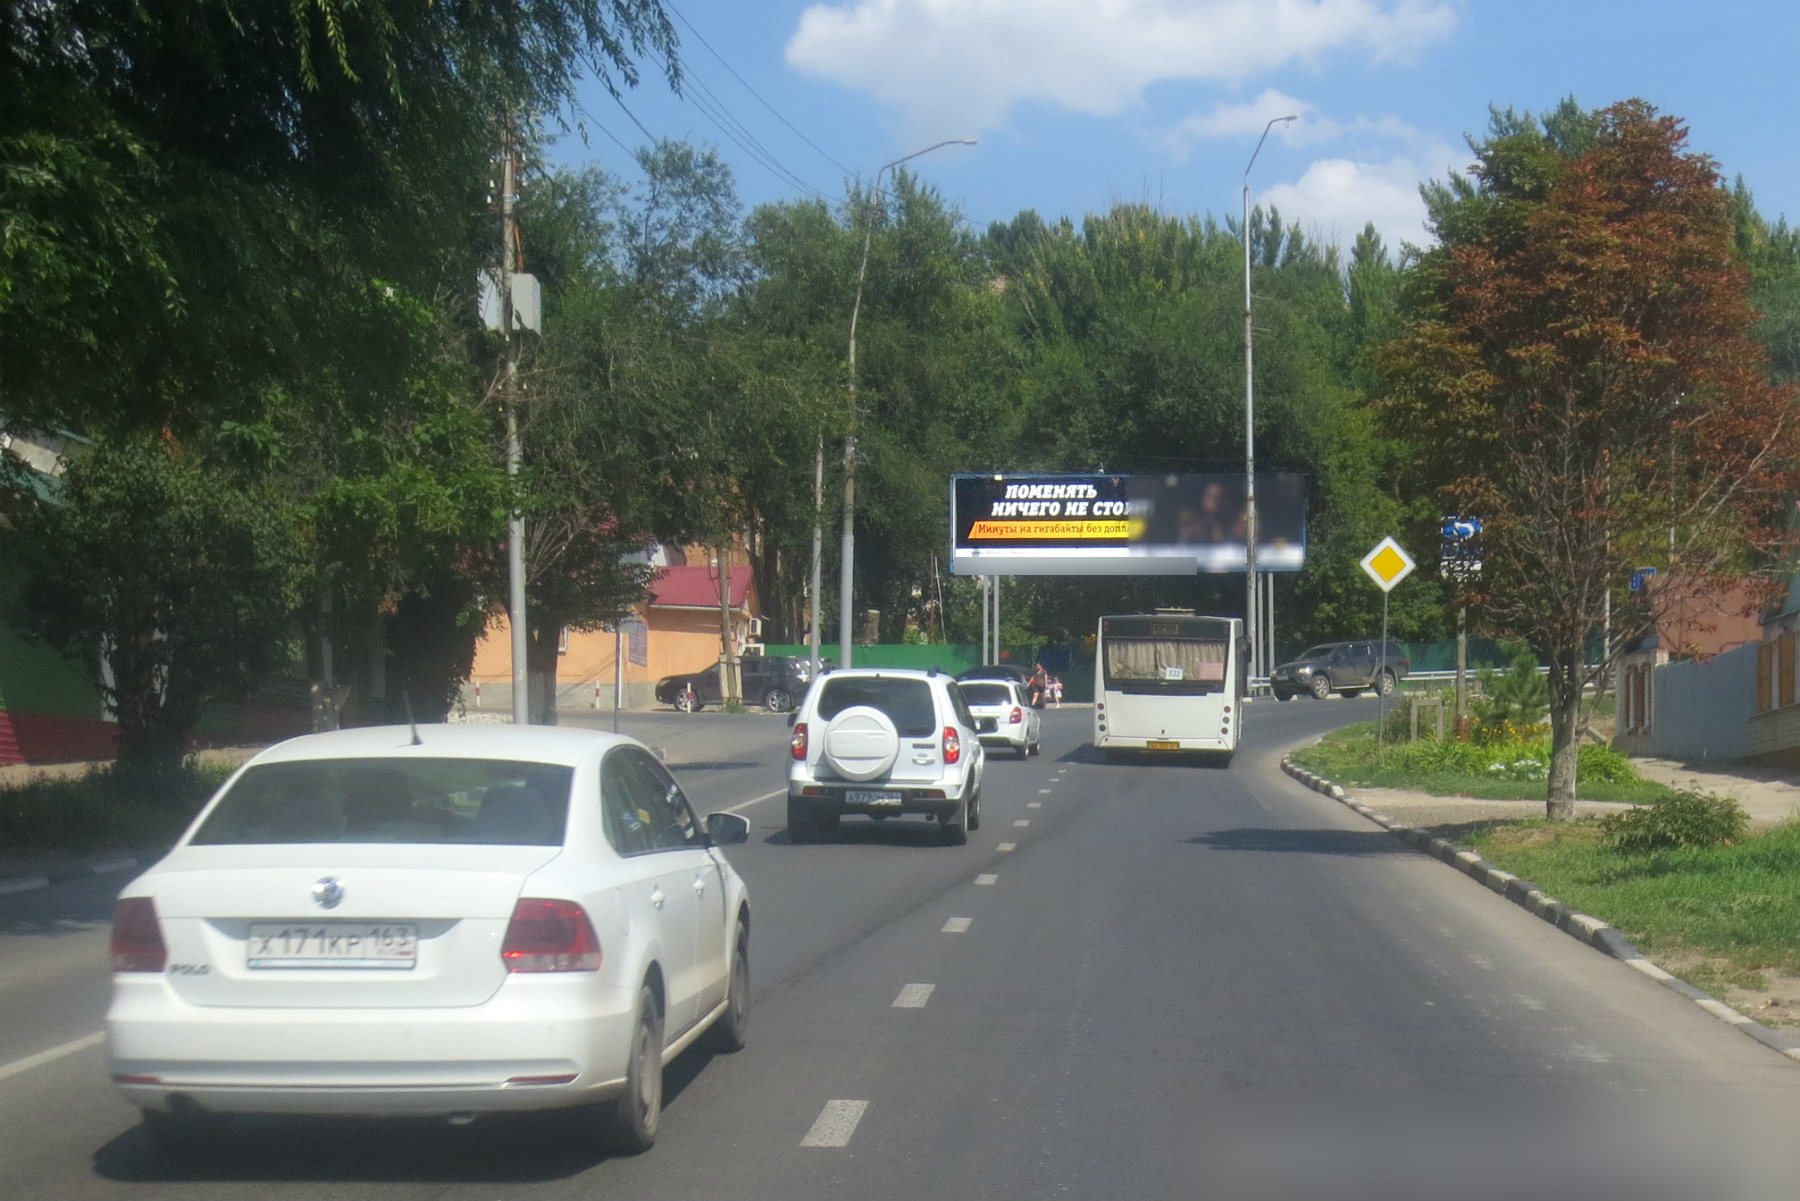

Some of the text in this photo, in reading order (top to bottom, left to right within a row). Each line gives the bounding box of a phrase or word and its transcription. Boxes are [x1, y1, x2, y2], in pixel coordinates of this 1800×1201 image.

[1004, 484, 1098, 499] ПОМЕНЯТЬ
[991, 501, 1061, 516] НИЧЕГО
[1064, 501, 1089, 516] НЕ
[978, 523, 1018, 536] Минуты
[1034, 523, 1084, 533] гигабайты
[1086, 523, 1102, 533] без
[258, 927, 409, 954] Х171КР 163
